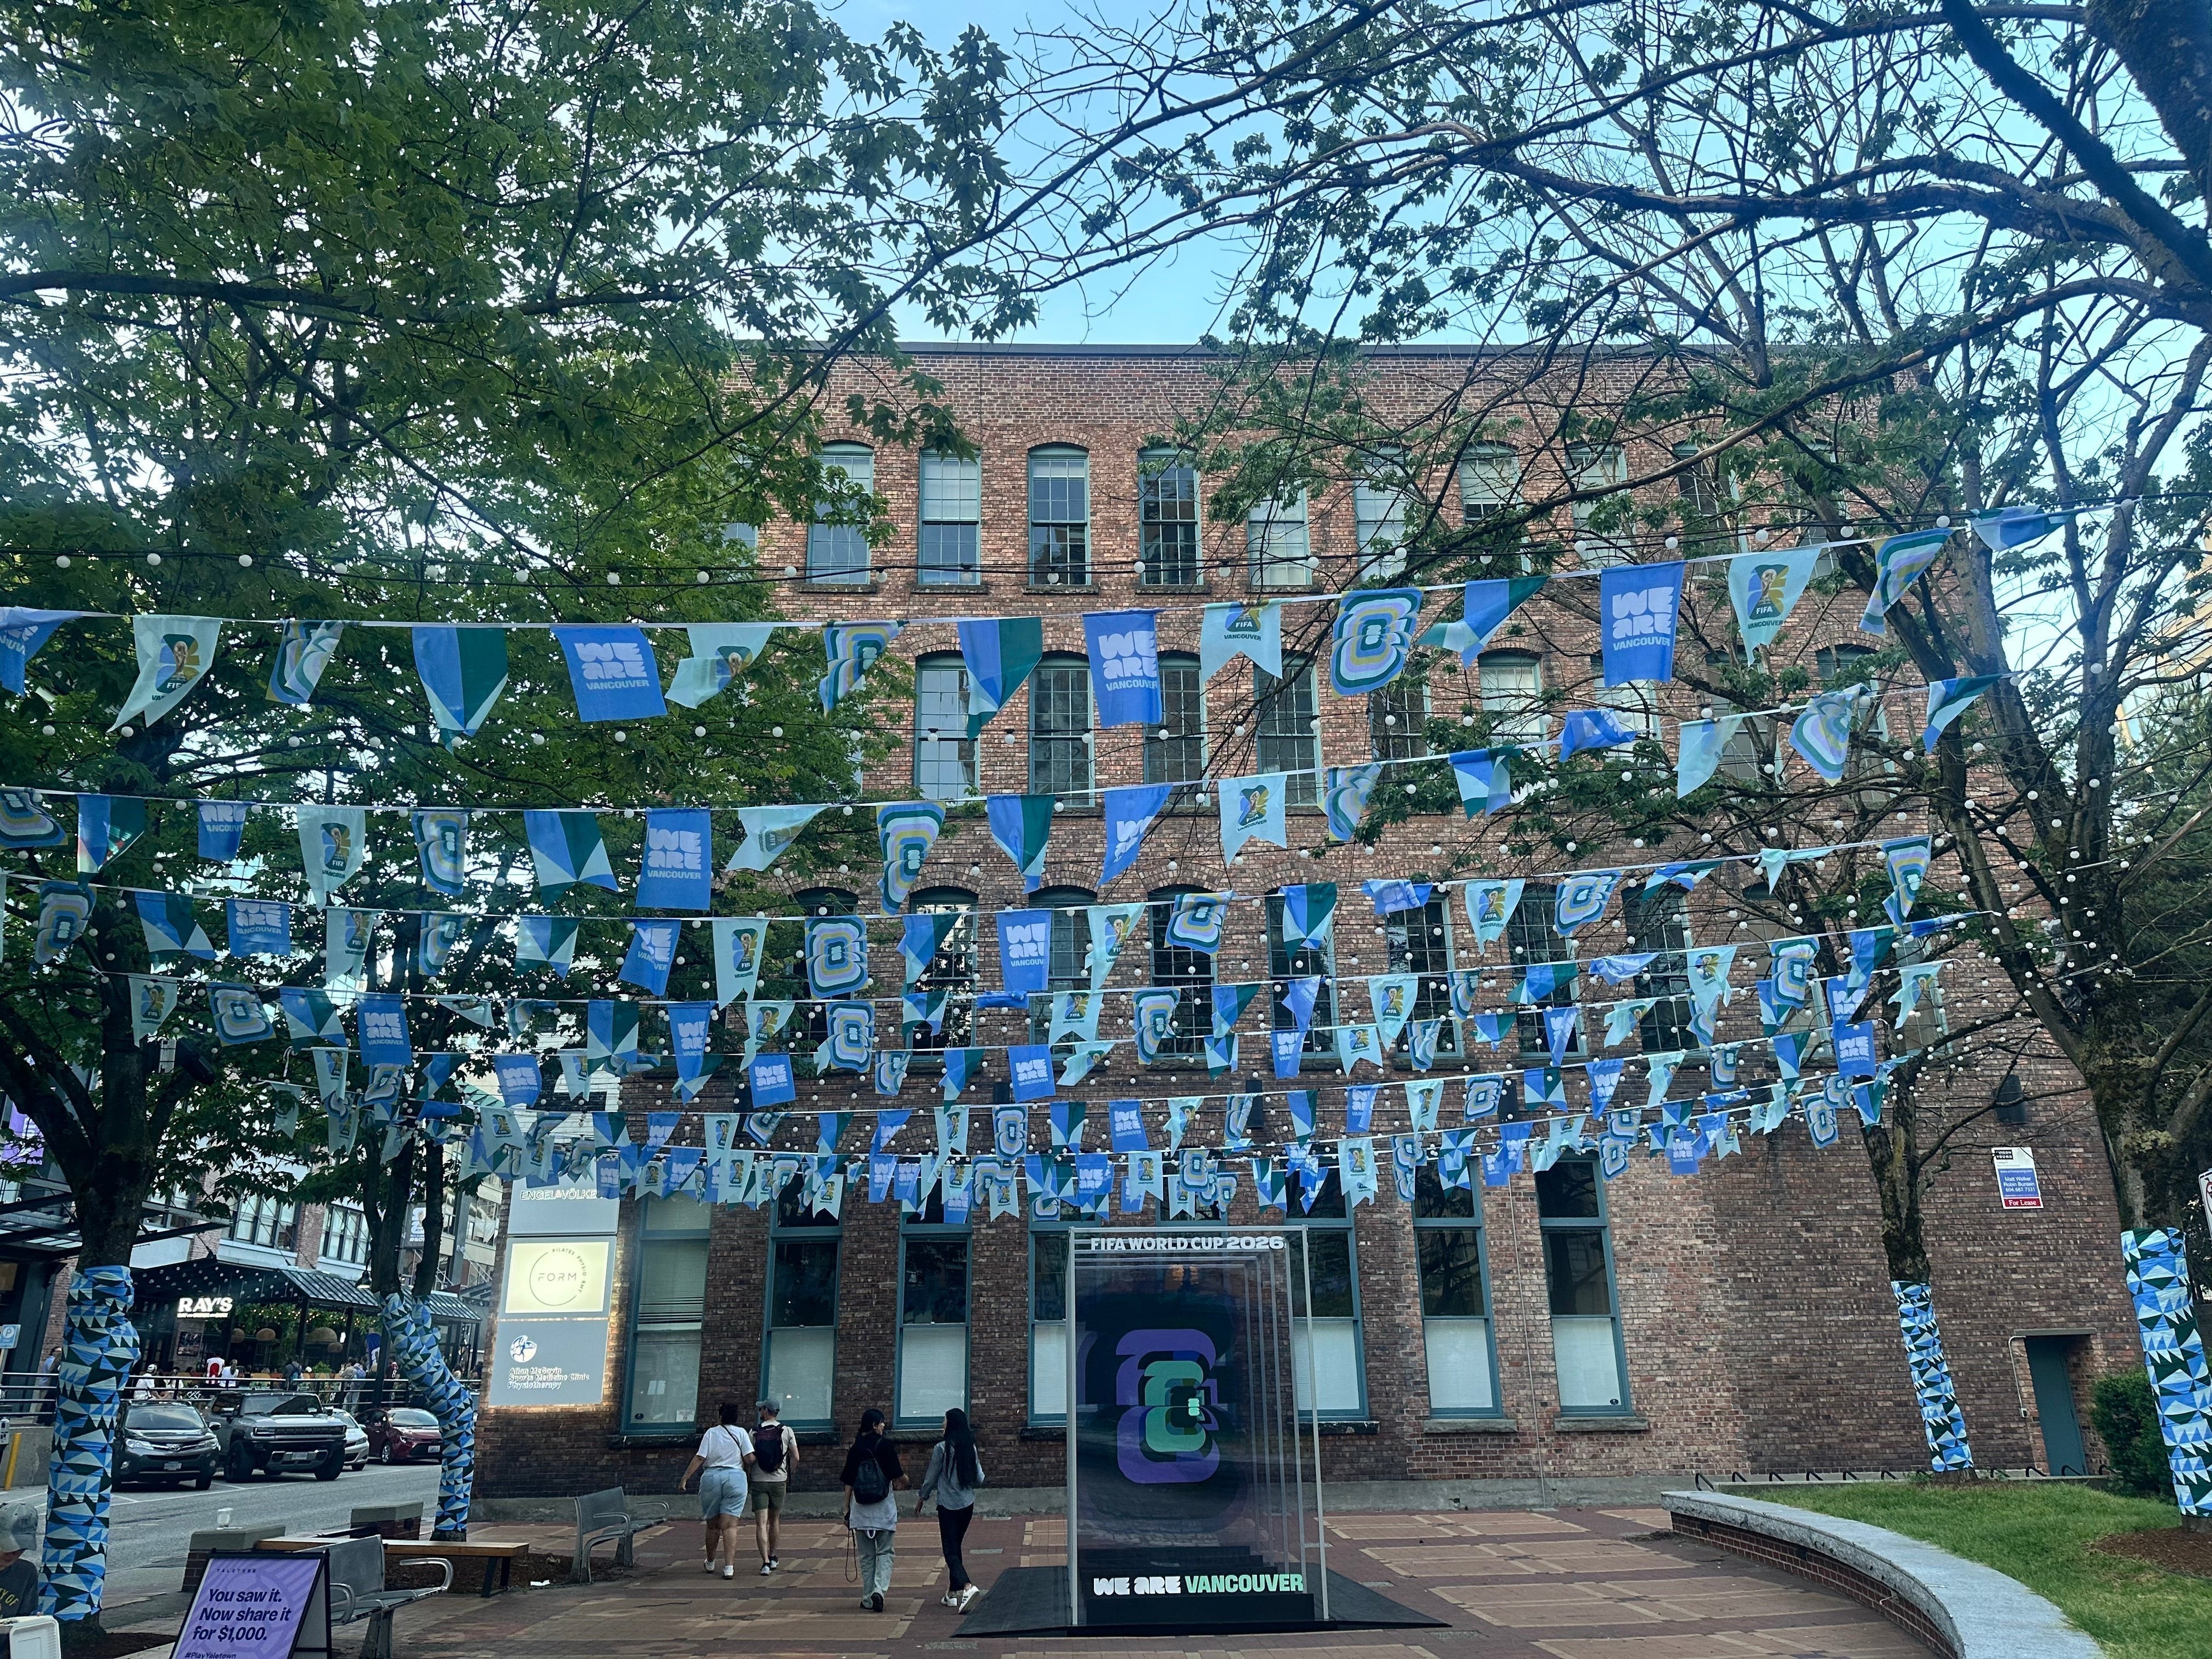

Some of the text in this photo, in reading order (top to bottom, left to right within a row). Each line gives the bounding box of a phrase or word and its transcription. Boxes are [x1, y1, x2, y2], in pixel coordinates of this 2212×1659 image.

[1612, 586, 1675, 618] WE
[1612, 612, 1673, 639] ARE
[1748, 620, 1783, 630] VANCOUVER
[1099, 631, 1156, 659] WE
[1613, 636, 1671, 651] VANCOUVER
[574, 643, 643, 661] WE
[582, 661, 647, 679] ARE
[1103, 658, 1157, 679] ARE
[586, 679, 650, 691] VANCOUVER
[1106, 679, 1157, 691] VANCOUVER
[649, 827, 701, 851] WE
[647, 850, 701, 869] ARE
[647, 870, 701, 880] VANCOUVER
[236, 912, 281, 927] ARE
[236, 926, 281, 934] VANCOUVER
[1010, 957, 1044, 967] VANCOUV
[364, 1012, 400, 1026] WE
[366, 1026, 403, 1039] ARE
[1839, 1036, 1869, 1050] WE
[1840, 1047, 1869, 1059] ARE
[755, 1065, 786, 1077] WE
[1016, 1059, 1047, 1073] WE
[756, 1074, 787, 1086] ARE
[1017, 1069, 1048, 1082] ARE
[1114, 1109, 1138, 1122] WE
[1115, 1120, 1141, 1131] ARE
[1091, 1236, 1285, 1251] FIFA WORLD CUP 2026
[538, 1272, 577, 1281] FORM
[178, 1297, 233, 1312] RAY'S
[509, 1373, 534, 1381] Sports
[535, 1373, 567, 1381] Medicine
[507, 1381, 562, 1390] Physiotherapy
[1094, 1573, 1304, 1596] WE ARE VANCOUVER
[209, 1588, 282, 1602] You saw it.
[199, 1607, 291, 1621] Now share it
[192, 1625, 267, 1642] for $1,000.
